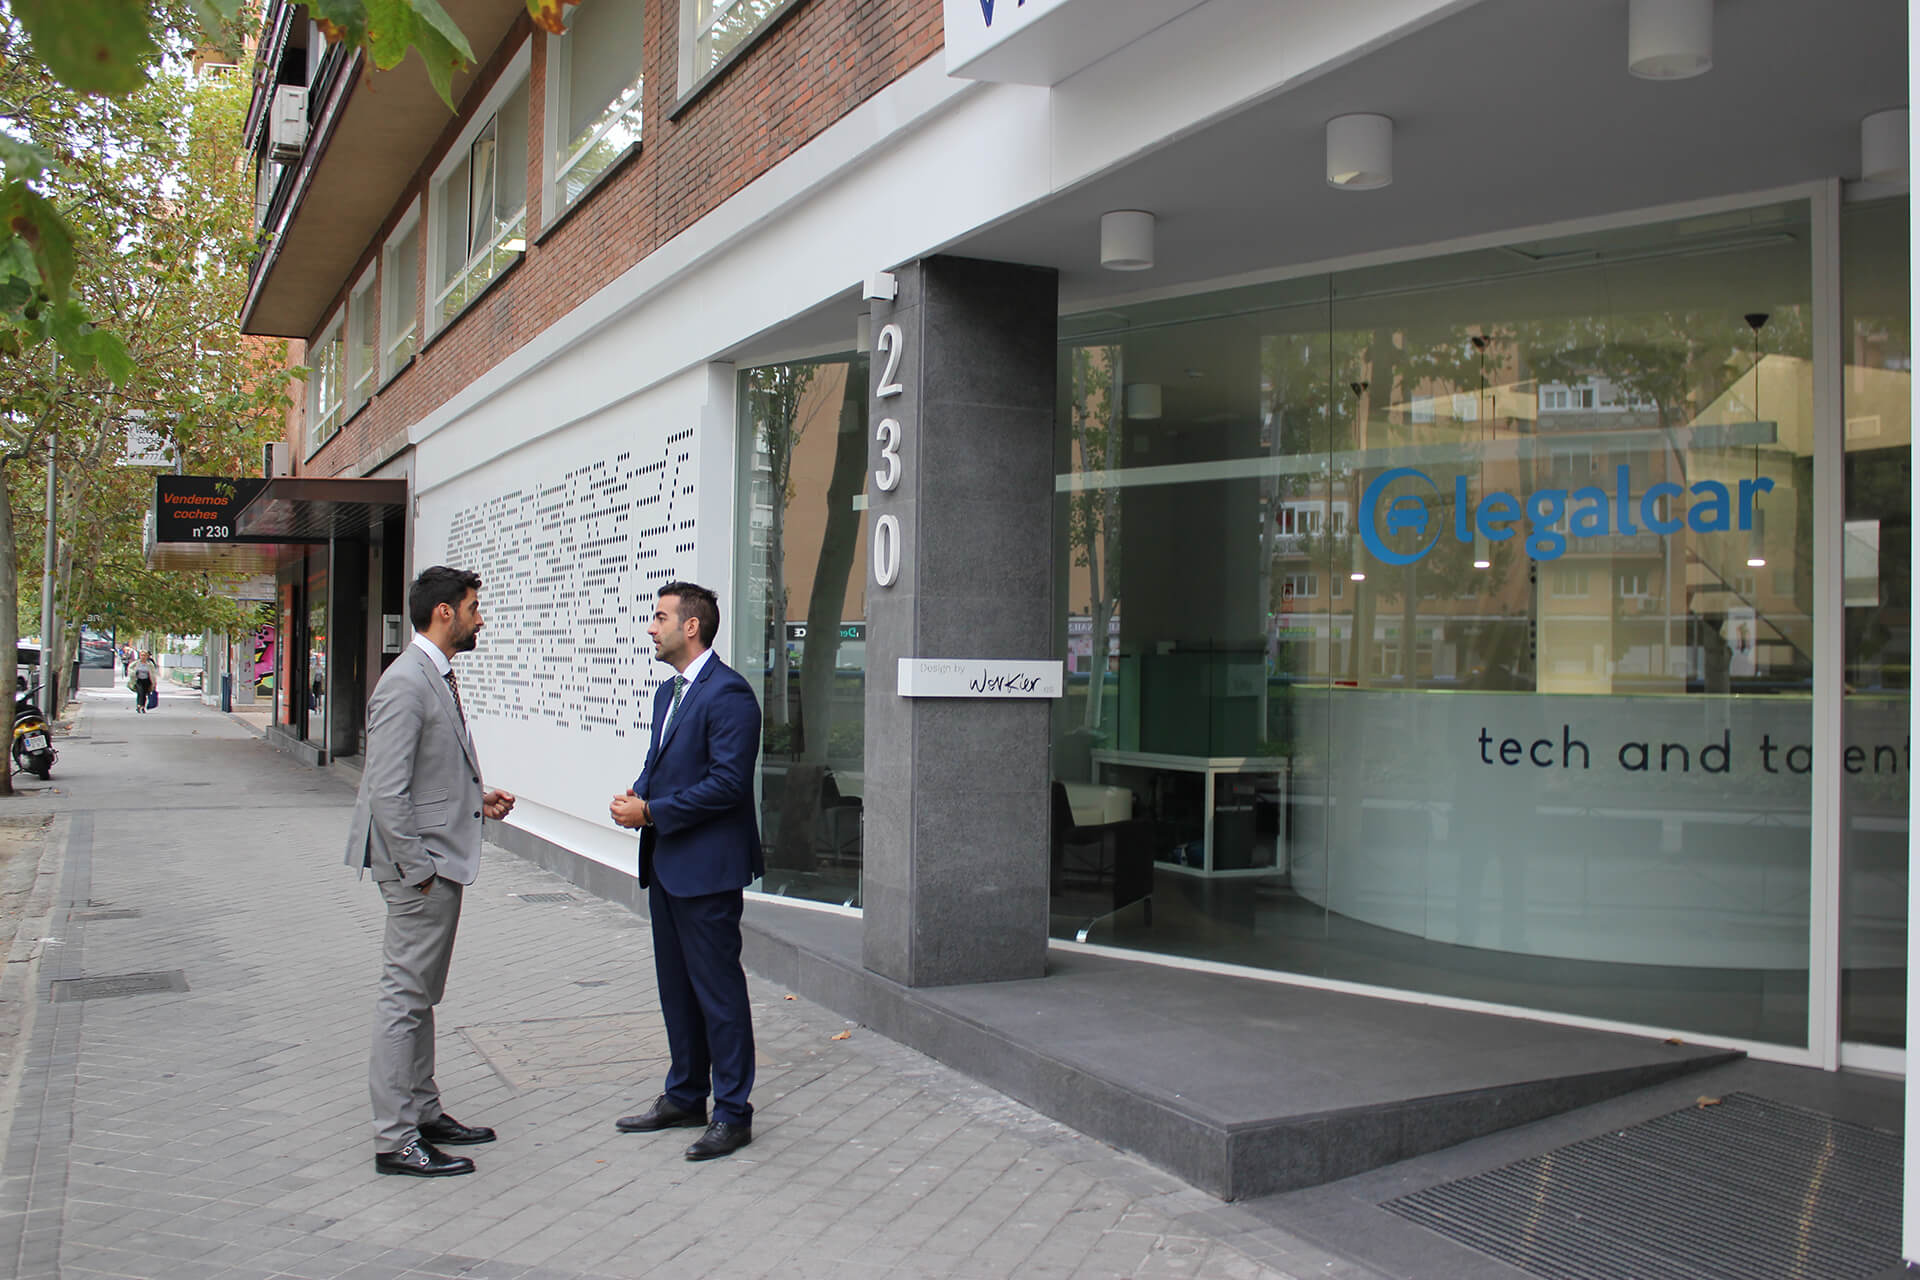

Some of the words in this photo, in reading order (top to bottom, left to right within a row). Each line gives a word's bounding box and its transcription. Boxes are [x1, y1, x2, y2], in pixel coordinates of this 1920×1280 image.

[874, 323, 903, 588] 230
[164, 493, 229, 505] Vendemos
[173, 509, 218, 519] coches
[1455, 464, 1776, 561] legalcar
[206, 525, 229, 538] 230
[920, 663, 951, 674] Design
[954, 663, 966, 674] by
[1478, 725, 1590, 769] tech
[1618, 729, 1731, 774] and
[1759, 734, 1911, 775] taen
